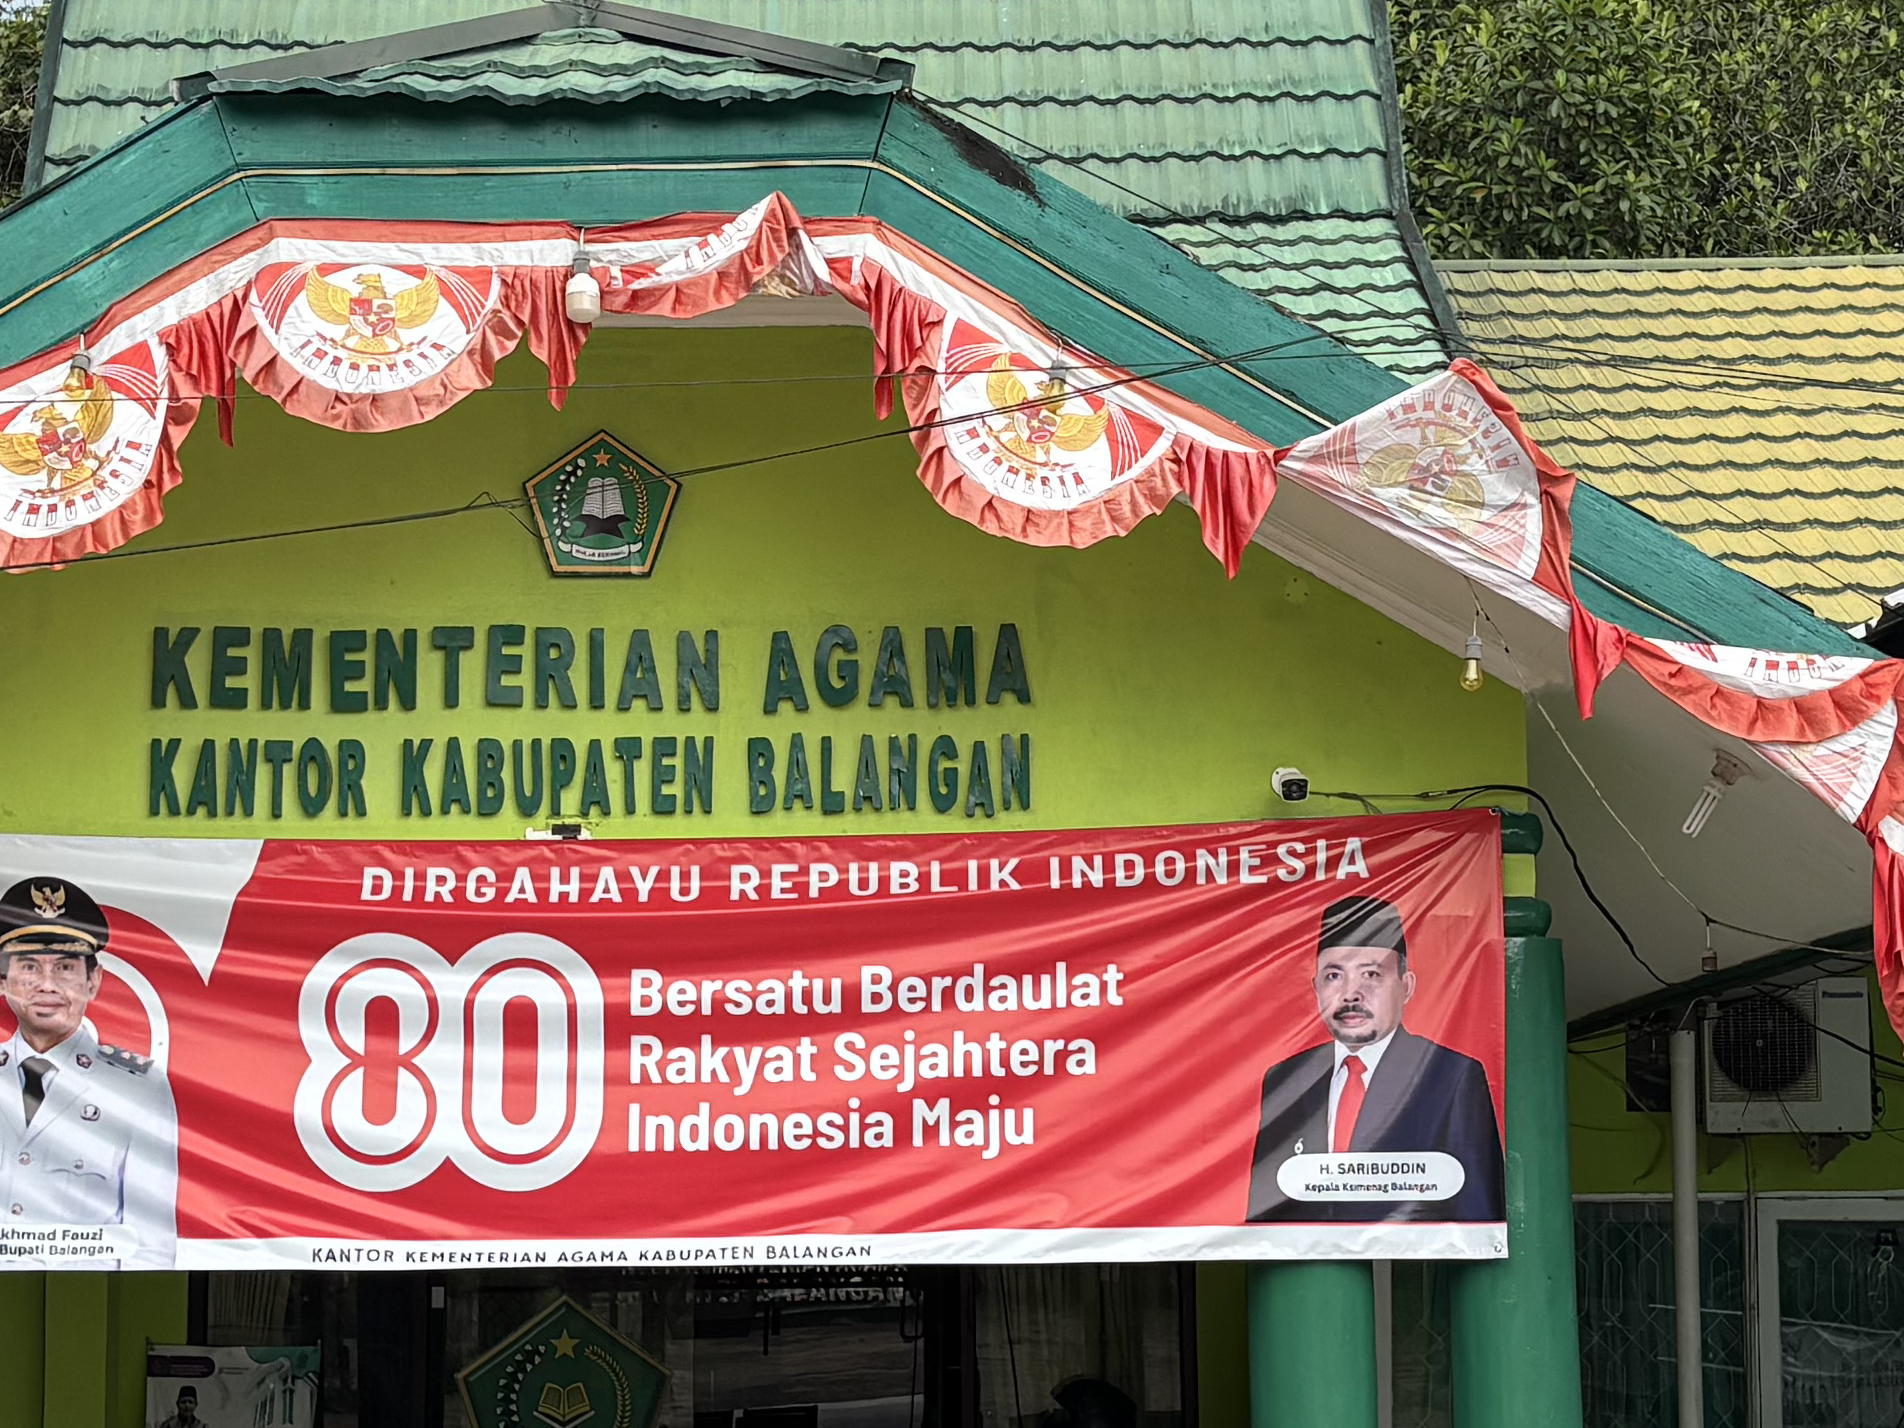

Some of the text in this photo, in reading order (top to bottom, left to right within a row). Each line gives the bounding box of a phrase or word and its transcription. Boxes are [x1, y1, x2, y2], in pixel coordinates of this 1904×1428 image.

[150, 623, 1031, 714] KEMENTERIAN AGAMA
[149, 732, 1031, 818] KANTOR KABUPATEN BALANGAN
[360, 838, 1371, 906] DIRGAHAYU REPUBLIK INDONESIA
[628, 960, 1124, 1019] Bersatu Berdaulat
[295, 932, 604, 1192] 80
[628, 1027, 1098, 1093] Rakyat Sejahtera
[626, 1097, 1036, 1160] Indonesia Maju
[1320, 1163, 1426, 1175] H. SARIBUDDIN
[0, 1243, 45, 1258] Bupati
[61, 1228, 104, 1242] Fauzi
[312, 1244, 872, 1264] KANTOR KEMENTERIAN AGAMA KABUPATEN BALANGAN
